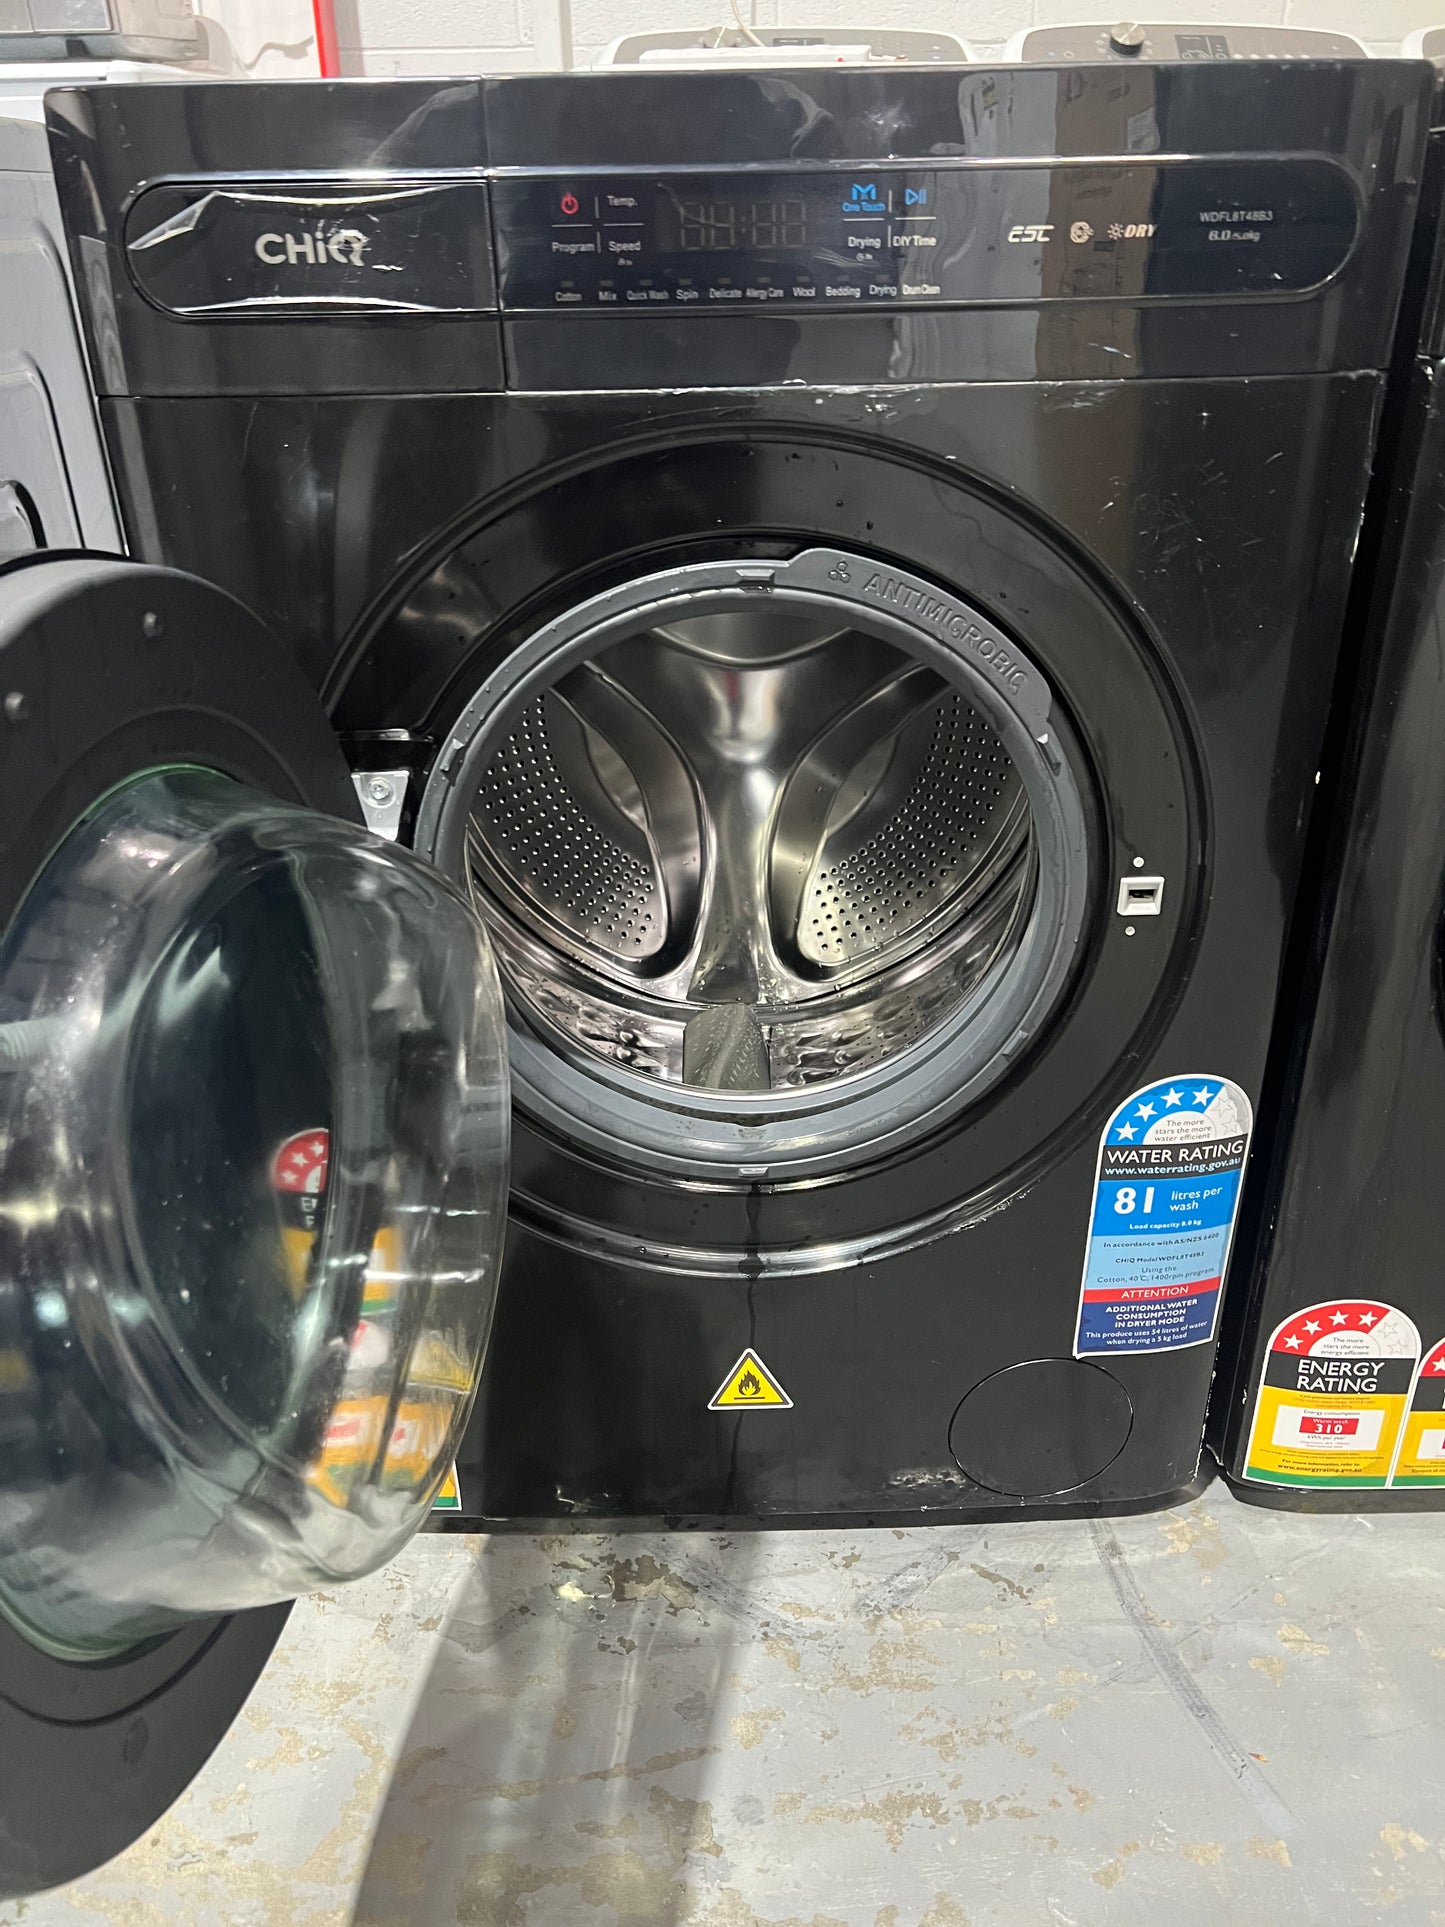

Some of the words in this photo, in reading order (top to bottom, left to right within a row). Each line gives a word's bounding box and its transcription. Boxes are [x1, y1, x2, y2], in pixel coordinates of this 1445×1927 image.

[1124, 224, 1158, 238] DRY
[848, 236, 881, 249] Drying
[893, 235, 911, 247] DIY
[912, 234, 937, 247] Time
[552, 242, 595, 255] Program
[608, 241, 641, 254] Speed
[555, 291, 582, 301] Cotton
[599, 291, 617, 300] Mix
[627, 290, 648, 300] Quick
[649, 290, 670, 300] Wash
[676, 289, 699, 301] Spin
[709, 288, 742, 299] Delicate
[792, 287, 816, 297] Wool
[825, 286, 861, 298] Bedding
[869, 285, 897, 296] Drying
[1179, 1133, 1211, 1141] efficient
[1107, 1150, 1172, 1164] WATER
[1178, 1140, 1244, 1162] RATING
[1105, 1157, 1241, 1176] www.waterrating.gov.au
[1171, 1190, 1200, 1201] litres
[1203, 1187, 1223, 1200] per
[1169, 1200, 1199, 1211] wash
[1149, 1222, 1180, 1230] capacity
[1151, 1273, 1184, 1282] 1400rpm
[1185, 1267, 1215, 1278] program
[1121, 1285, 1189, 1299] ATTENTION
[1105, 1302, 1166, 1314] ADDITIONAL
[1167, 1298, 1198, 1309] WATER
[1115, 1308, 1187, 1321] CONSUMPTION
[1127, 1319, 1157, 1328] DRYER
[1158, 1316, 1185, 1326] MODE
[1102, 1331, 1133, 1340] produce
[1151, 1328, 1161, 1336] 54
[1161, 1325, 1180, 1334] litres
[1180, 1323, 1190, 1332] of
[1189, 1320, 1208, 1330] water
[1127, 1337, 1150, 1346] drying
[1162, 1335, 1172, 1343] kg
[1172, 1332, 1188, 1340] load
[1297, 1359, 1385, 1377] ENERGY
[1297, 1376, 1378, 1393] RATING
[1314, 1424, 1343, 1434] 310
